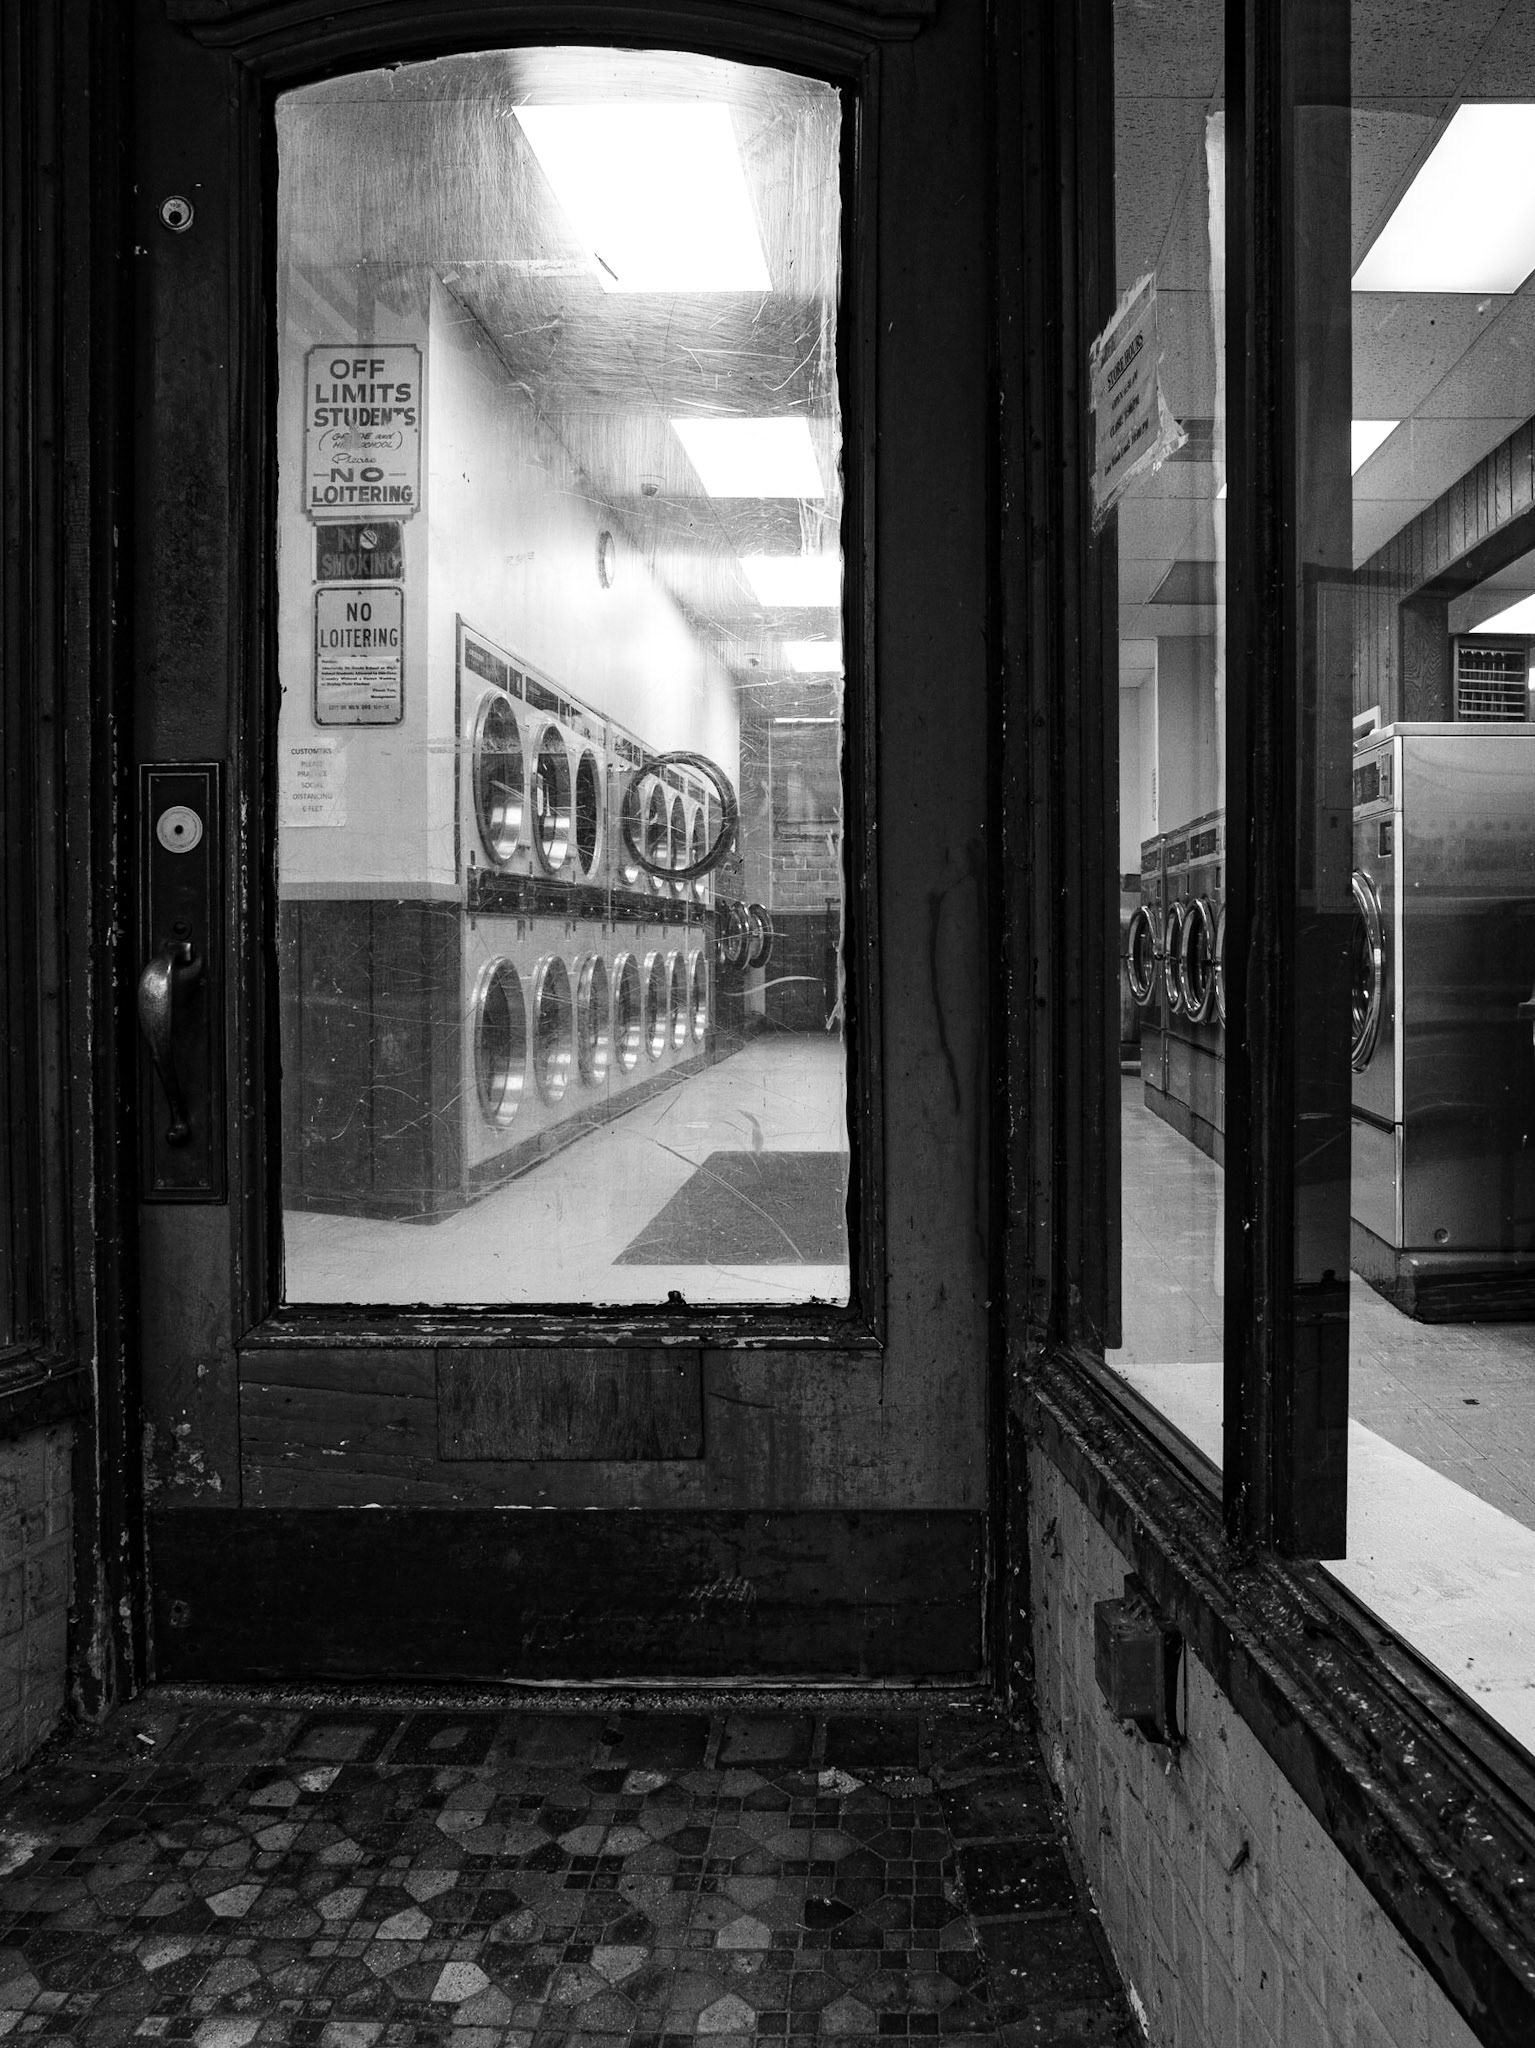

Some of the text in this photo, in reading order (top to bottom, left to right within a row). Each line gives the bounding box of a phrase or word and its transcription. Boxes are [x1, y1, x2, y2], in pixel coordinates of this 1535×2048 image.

[330, 359, 385, 380] OFF
[1107, 331, 1144, 388] STORE HOURS
[316, 383, 411, 403] LIMITS
[314, 407, 416, 427] STUDENTS
[332, 453, 377, 464] Please
[331, 467, 384, 483] NO
[312, 485, 413, 503] LOITERING
[322, 552, 398, 576] SMOKING
[347, 603, 372, 622] NO
[320, 628, 398, 648] LOITERING
